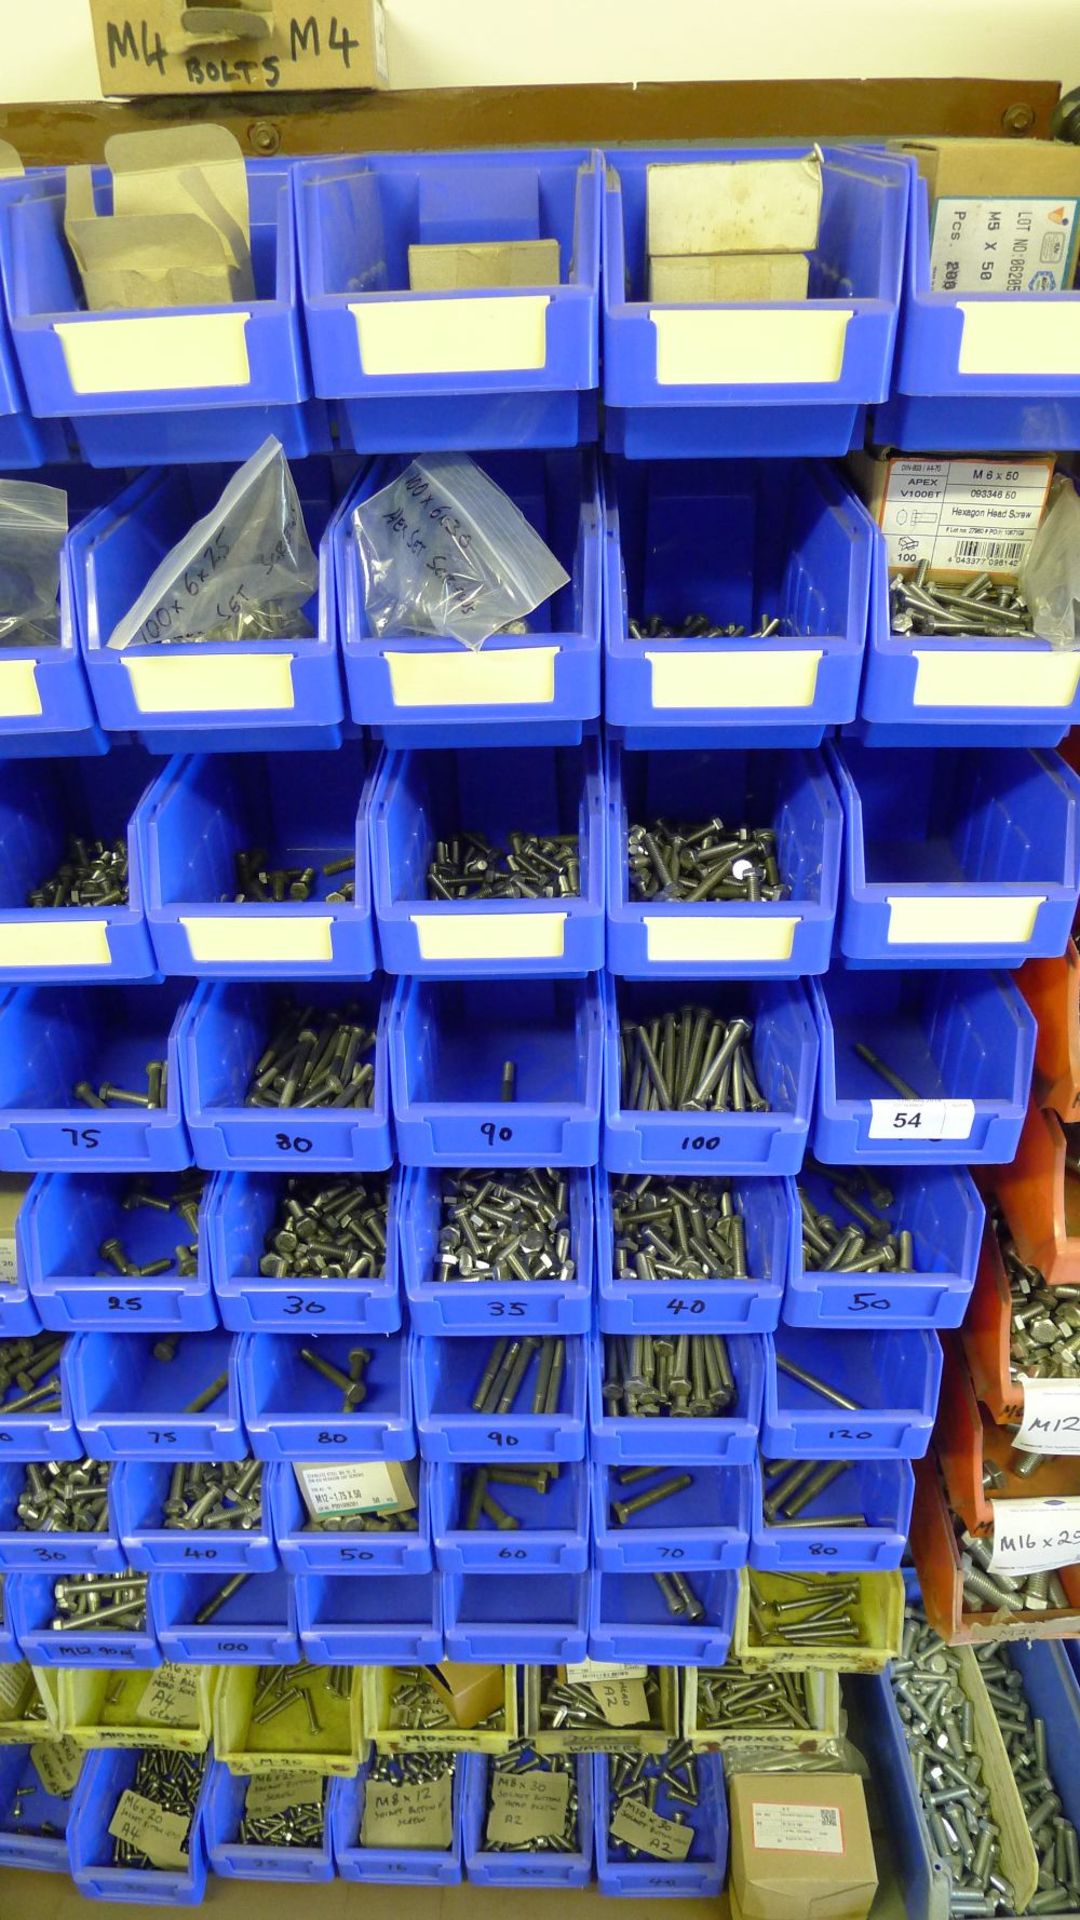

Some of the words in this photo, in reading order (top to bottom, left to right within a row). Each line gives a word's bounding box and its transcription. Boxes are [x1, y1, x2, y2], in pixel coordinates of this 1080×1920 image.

[107, 20, 168, 75] M4
[290, 16, 359, 68] M4
[186, 56, 280, 87] BOLTS
[950, 211, 966, 247] Pcs.
[987, 211, 1001, 231] M5
[1016, 212, 1032, 232] LOT
[984, 241, 998, 251] X
[980, 261, 994, 281] 50
[908, 478, 938, 486] APEX
[973, 470, 983, 479] M
[986, 471, 993, 479] 6
[1005, 472, 1019, 481] 50
[952, 507, 984, 518] Hexagon
[986, 508, 1006, 517] Head
[1008, 510, 1032, 519] Screw
[897, 553, 917, 562] 100
[893, 1112, 922, 1128] 54
[61, 1128, 100, 1148] 75
[480, 1122, 513, 1146] 90
[275, 1133, 313, 1153] 80
[681, 1135, 721, 1151] 100
[107, 1296, 142, 1311] 25
[283, 1296, 326, 1315] 30
[486, 1301, 528, 1317] 35
[666, 1298, 705, 1315] 40
[847, 1292, 891, 1312] 50
[1028, 1416, 1080, 1432] M12
[147, 1431, 177, 1444] 75
[317, 1431, 348, 1444] 80
[486, 1431, 519, 1447] 90
[828, 1429, 873, 1440] 120
[808, 1543, 838, 1556] 80
[1000, 1534, 1036, 1552] M16
[1042, 1537, 1053, 1548] x
[33, 1547, 66, 1562] 30
[184, 1547, 217, 1559] 40
[340, 1548, 375, 1561] 50
[499, 1548, 527, 1559] 60
[657, 1547, 685, 1559] 70
[217, 1642, 248, 1652] 100
[152, 1690, 174, 1711] A4
[603, 1686, 618, 1708] A2
[122, 1822, 140, 1840] A4
[650, 1839, 673, 1854] A2
